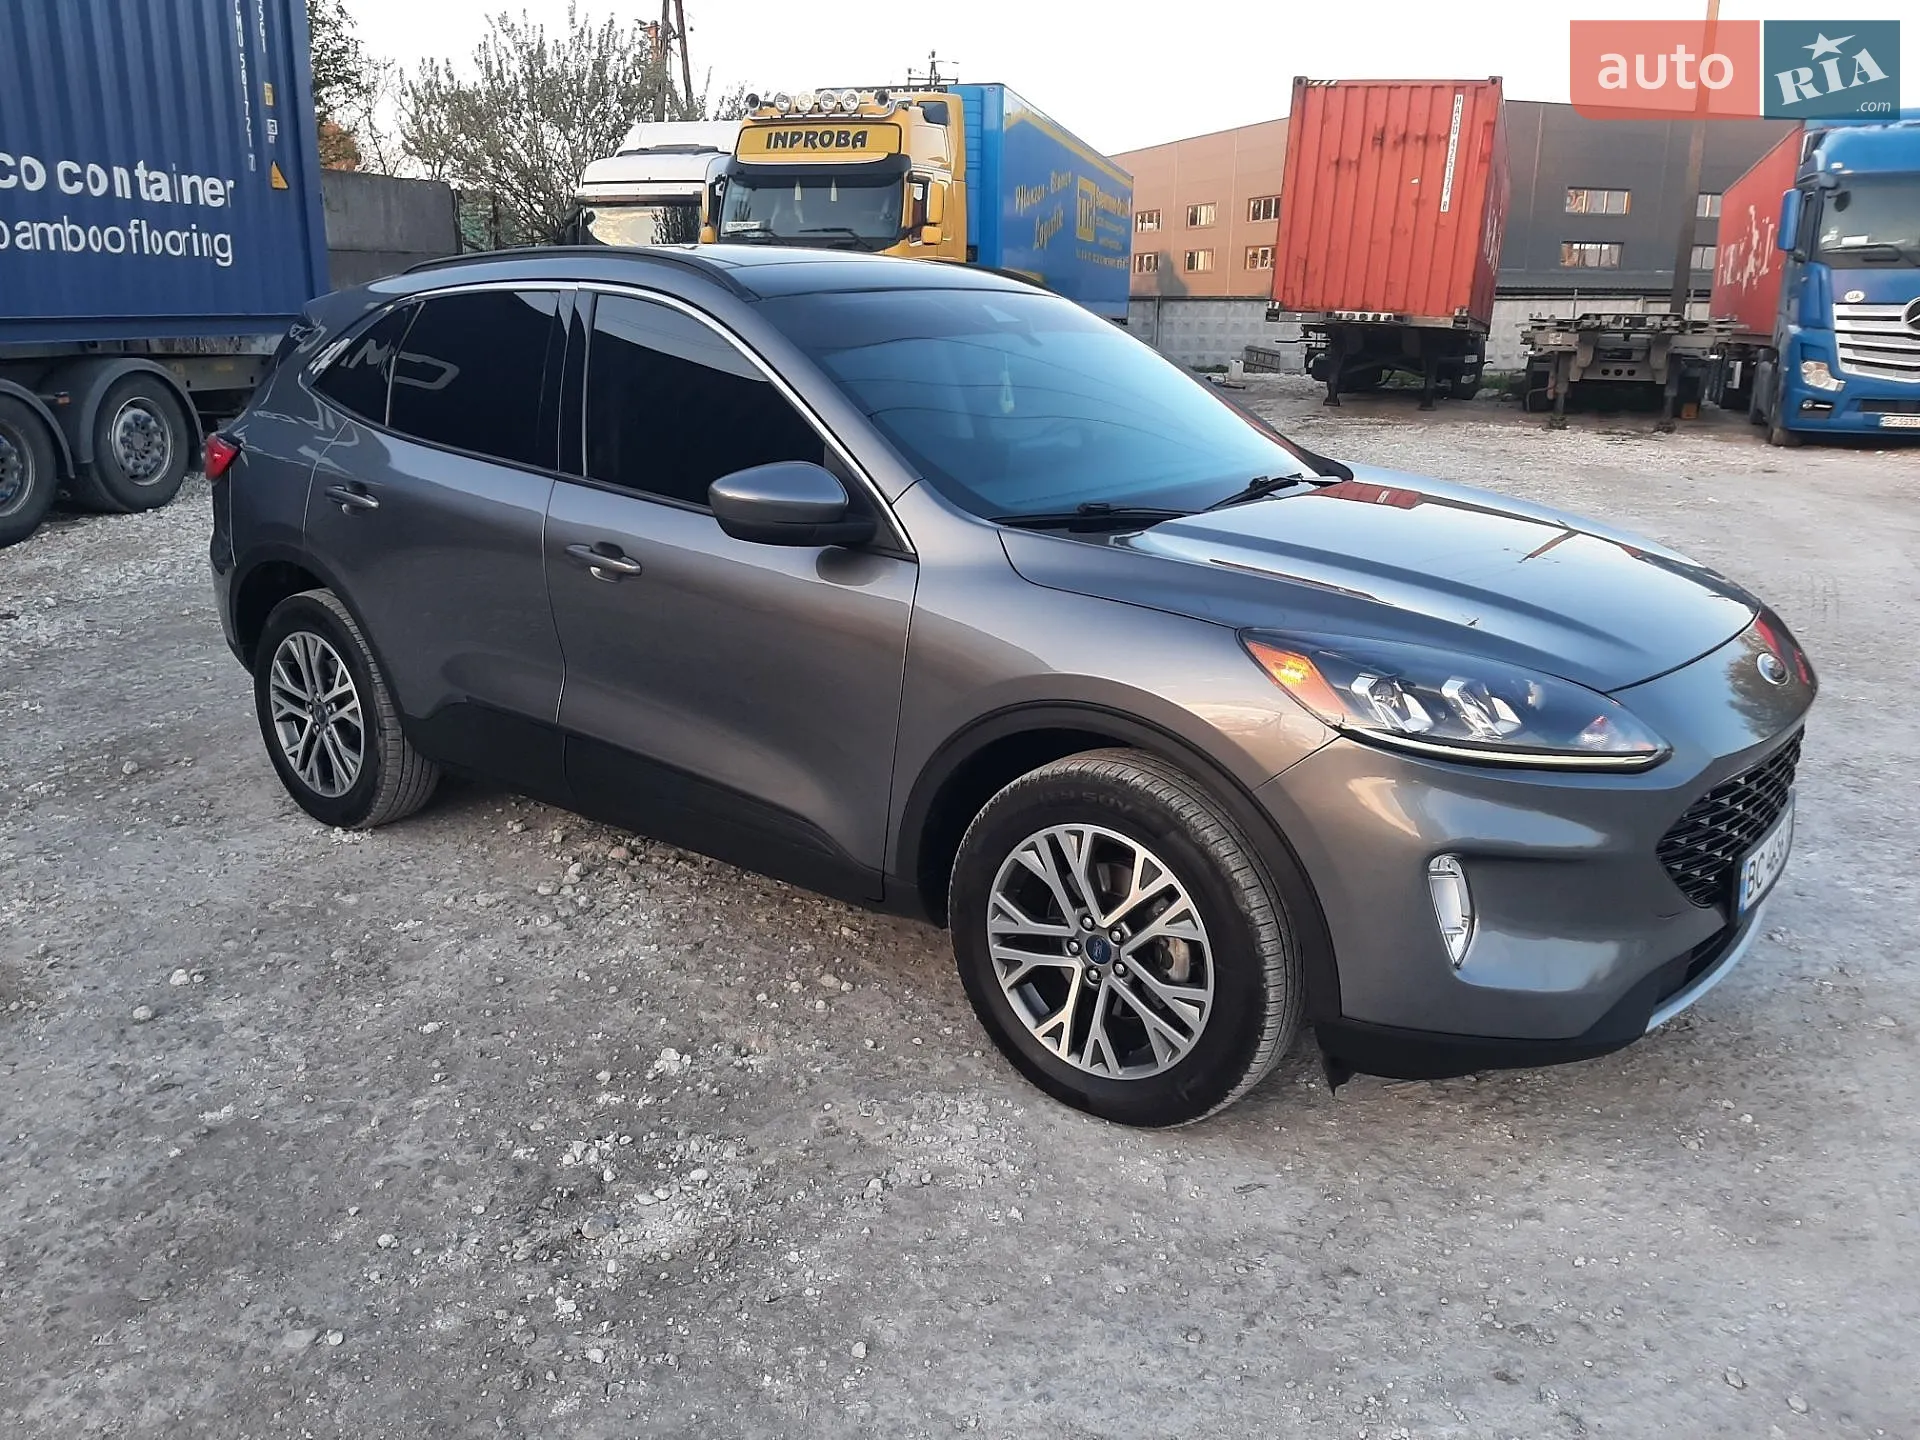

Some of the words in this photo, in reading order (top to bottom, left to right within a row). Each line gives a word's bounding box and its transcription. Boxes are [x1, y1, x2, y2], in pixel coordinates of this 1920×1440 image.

[257, 0, 267, 53] 5G1
[766, 130, 868, 150] INPROBA
[57, 160, 234, 208] container
[128, 219, 233, 267] flooring
